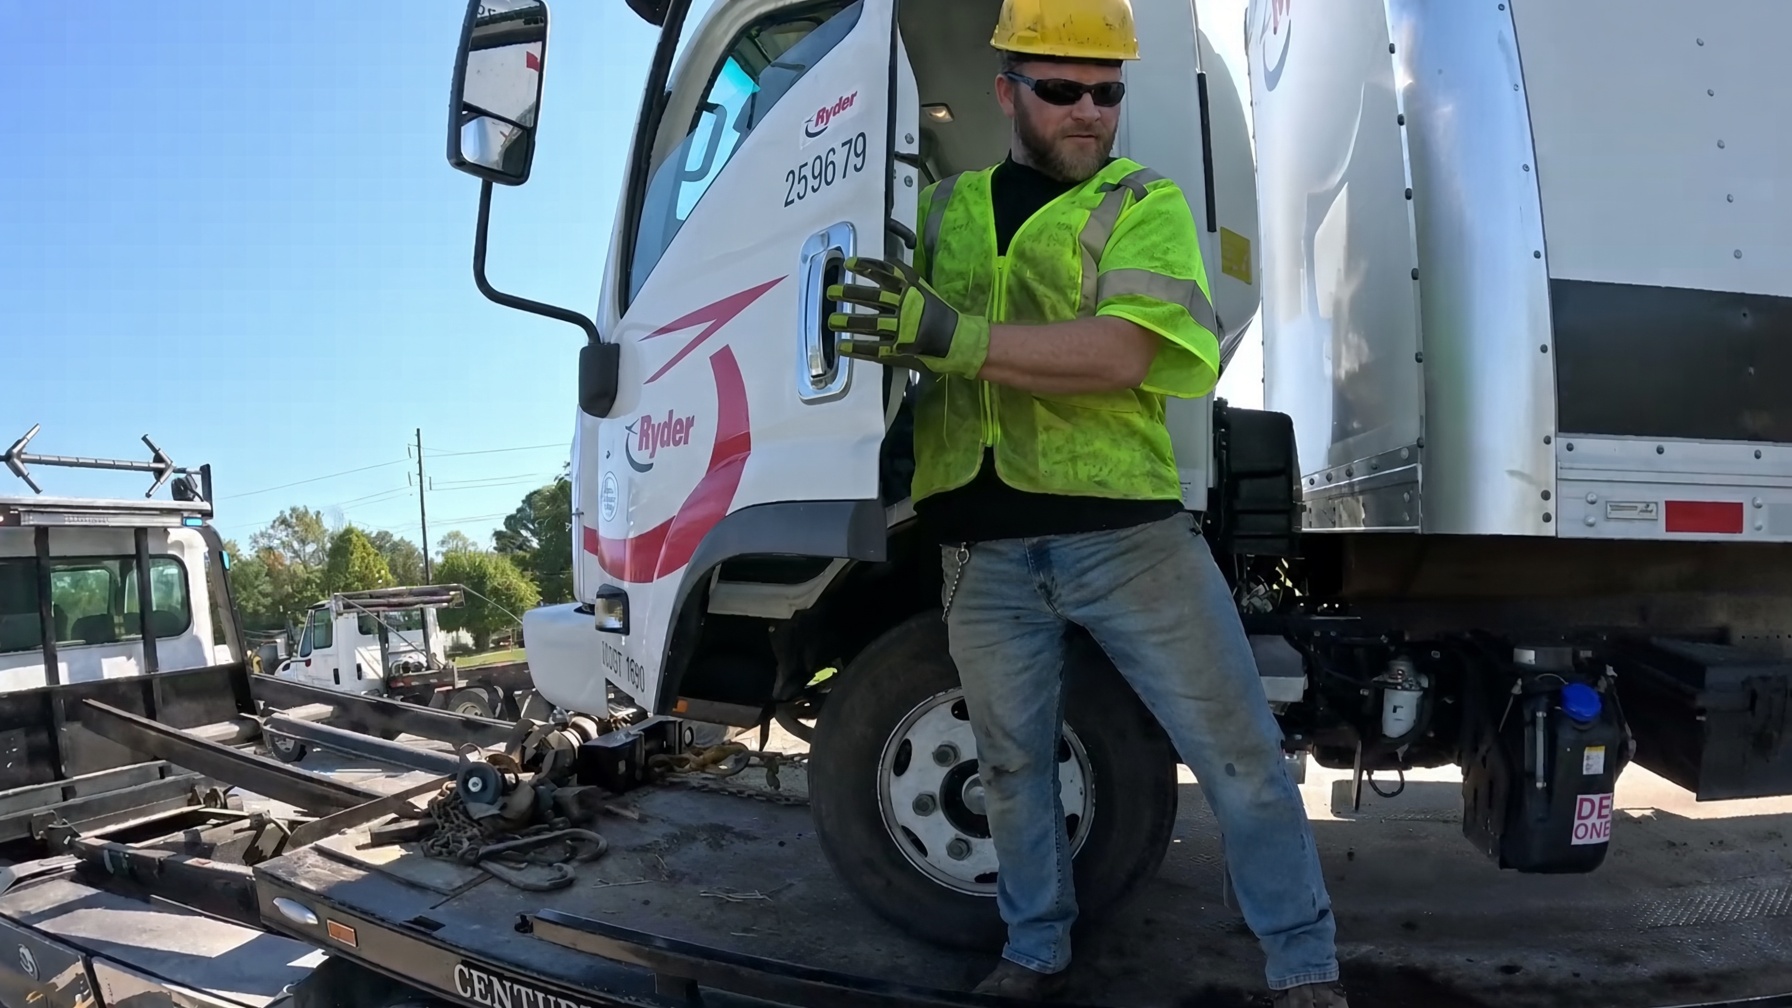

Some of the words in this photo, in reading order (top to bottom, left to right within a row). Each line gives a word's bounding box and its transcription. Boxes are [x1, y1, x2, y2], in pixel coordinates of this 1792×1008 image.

[815, 90, 858, 128] Ryder
[784, 131, 867, 208] 259679
[637, 408, 695, 459] Ryder
[626, 656, 645, 693] 1690
